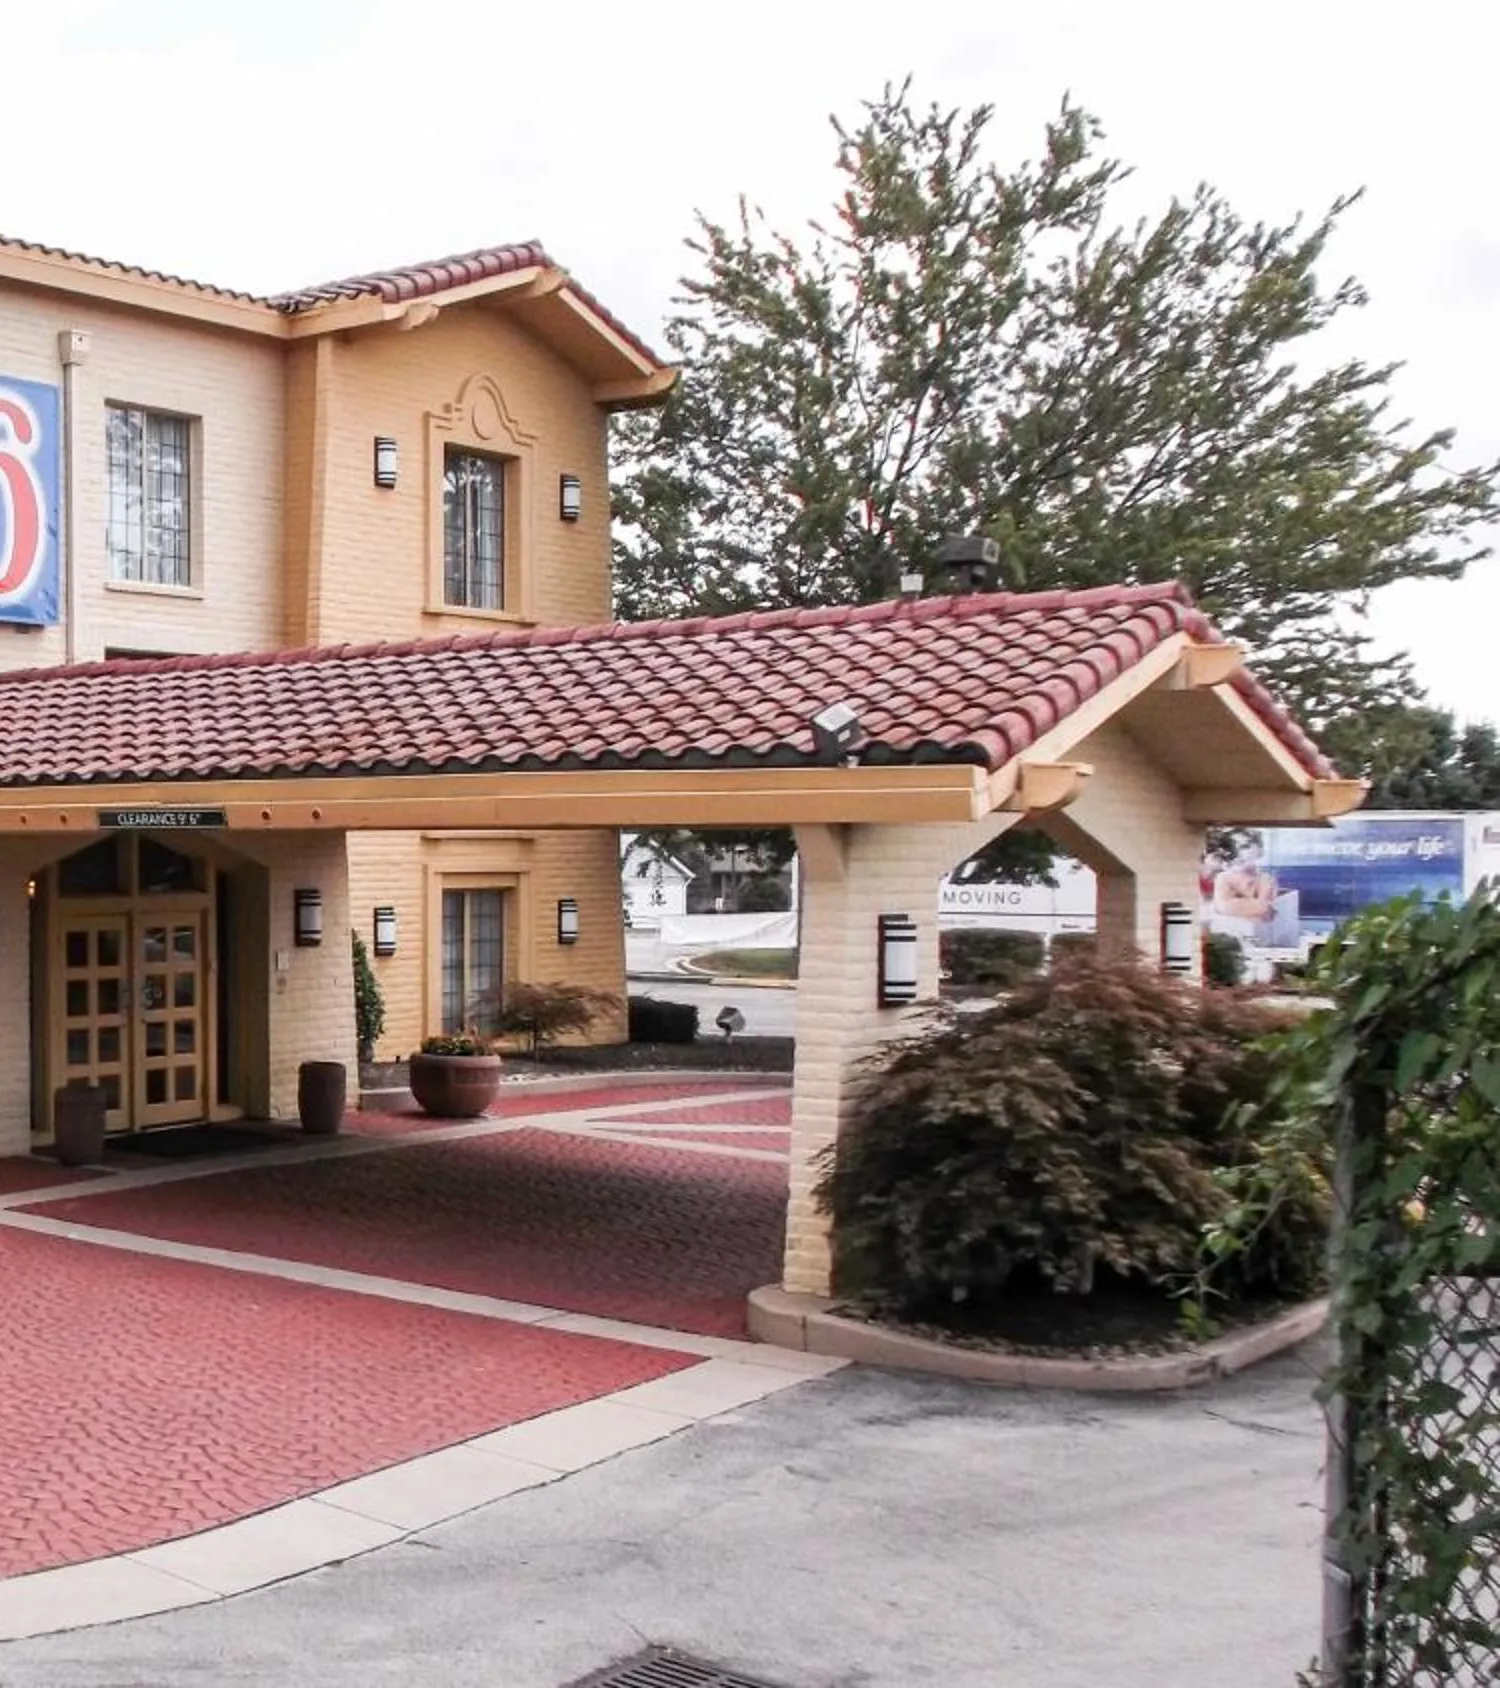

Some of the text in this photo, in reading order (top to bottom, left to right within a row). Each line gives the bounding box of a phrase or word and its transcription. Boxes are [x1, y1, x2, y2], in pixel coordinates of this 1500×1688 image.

[117, 812, 176, 825] CLEARANCE
[1364, 841, 1415, 861] your
[1417, 835, 1445, 861] life
[942, 890, 1022, 905] MOVING
